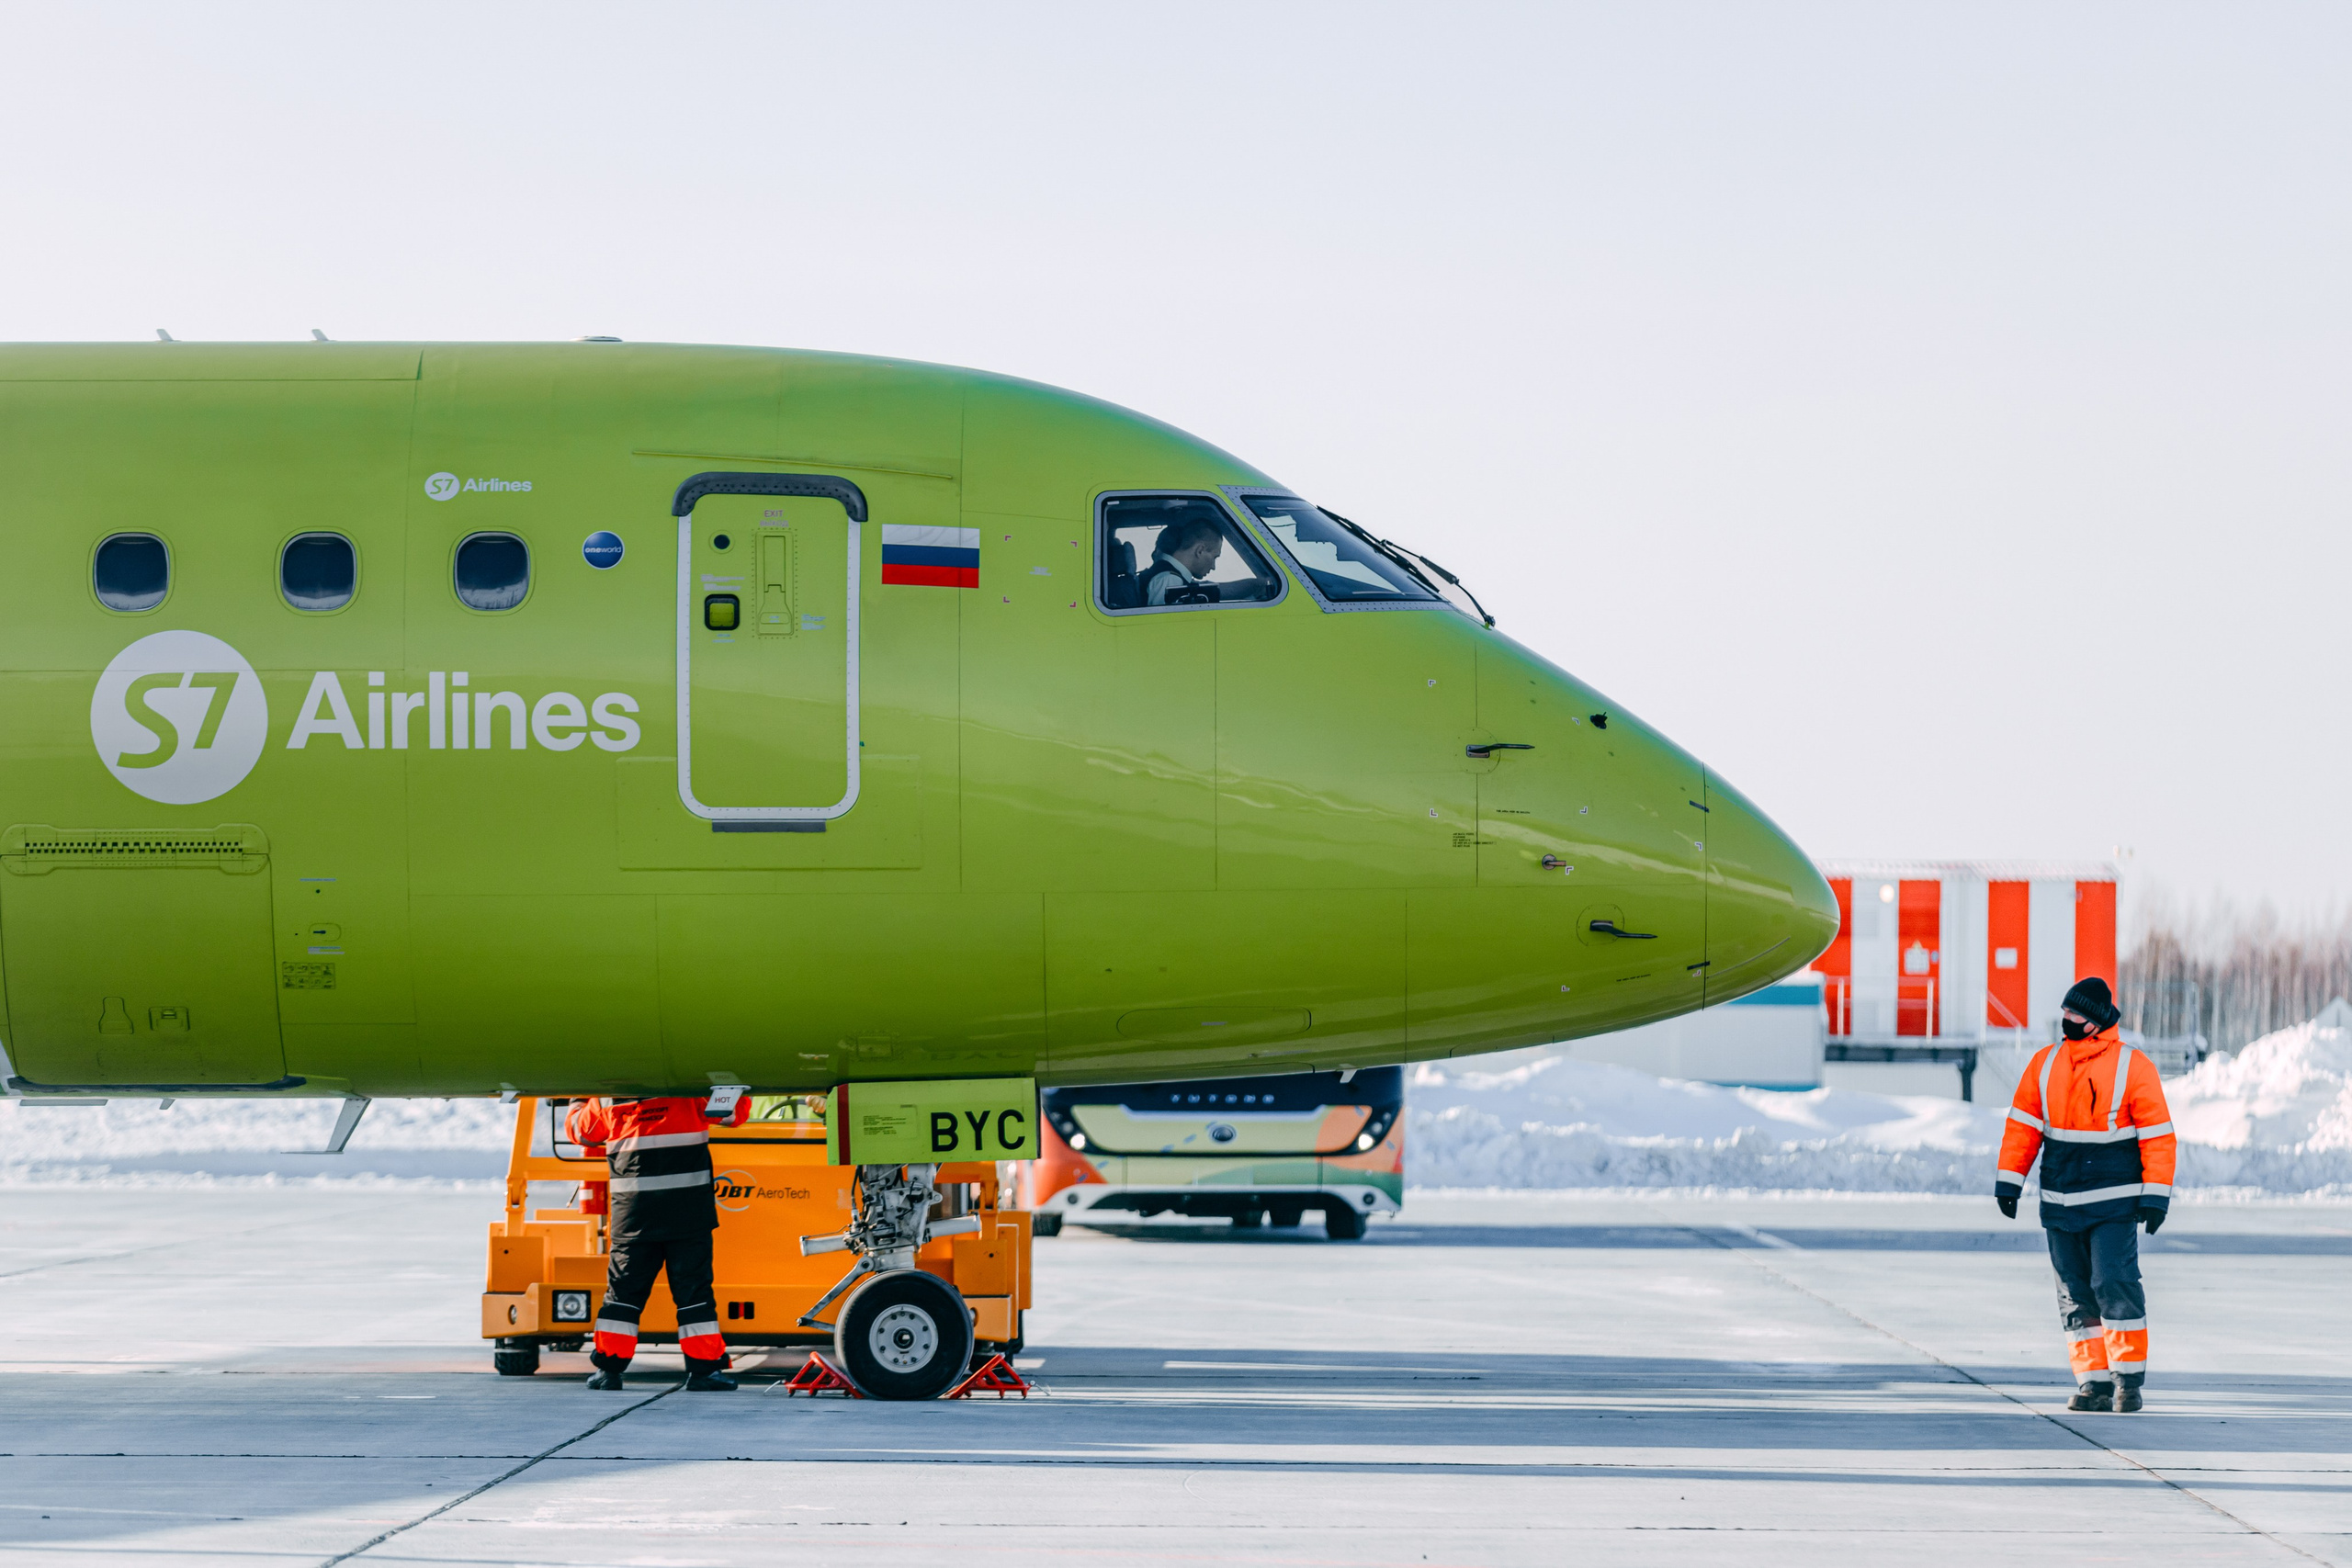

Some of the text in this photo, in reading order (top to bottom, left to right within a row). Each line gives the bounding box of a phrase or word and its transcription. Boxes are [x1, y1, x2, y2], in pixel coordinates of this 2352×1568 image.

[430, 478, 533, 494] S7 Airlines
[763, 510, 784, 518] EXIT
[584, 546, 622, 554] oneworld
[117, 671, 641, 769] S7 Airlines
[714, 1096, 731, 1104] HOT
[931, 1109, 1025, 1152] BYC
[718, 1186, 810, 1199] JBT AeroTech
